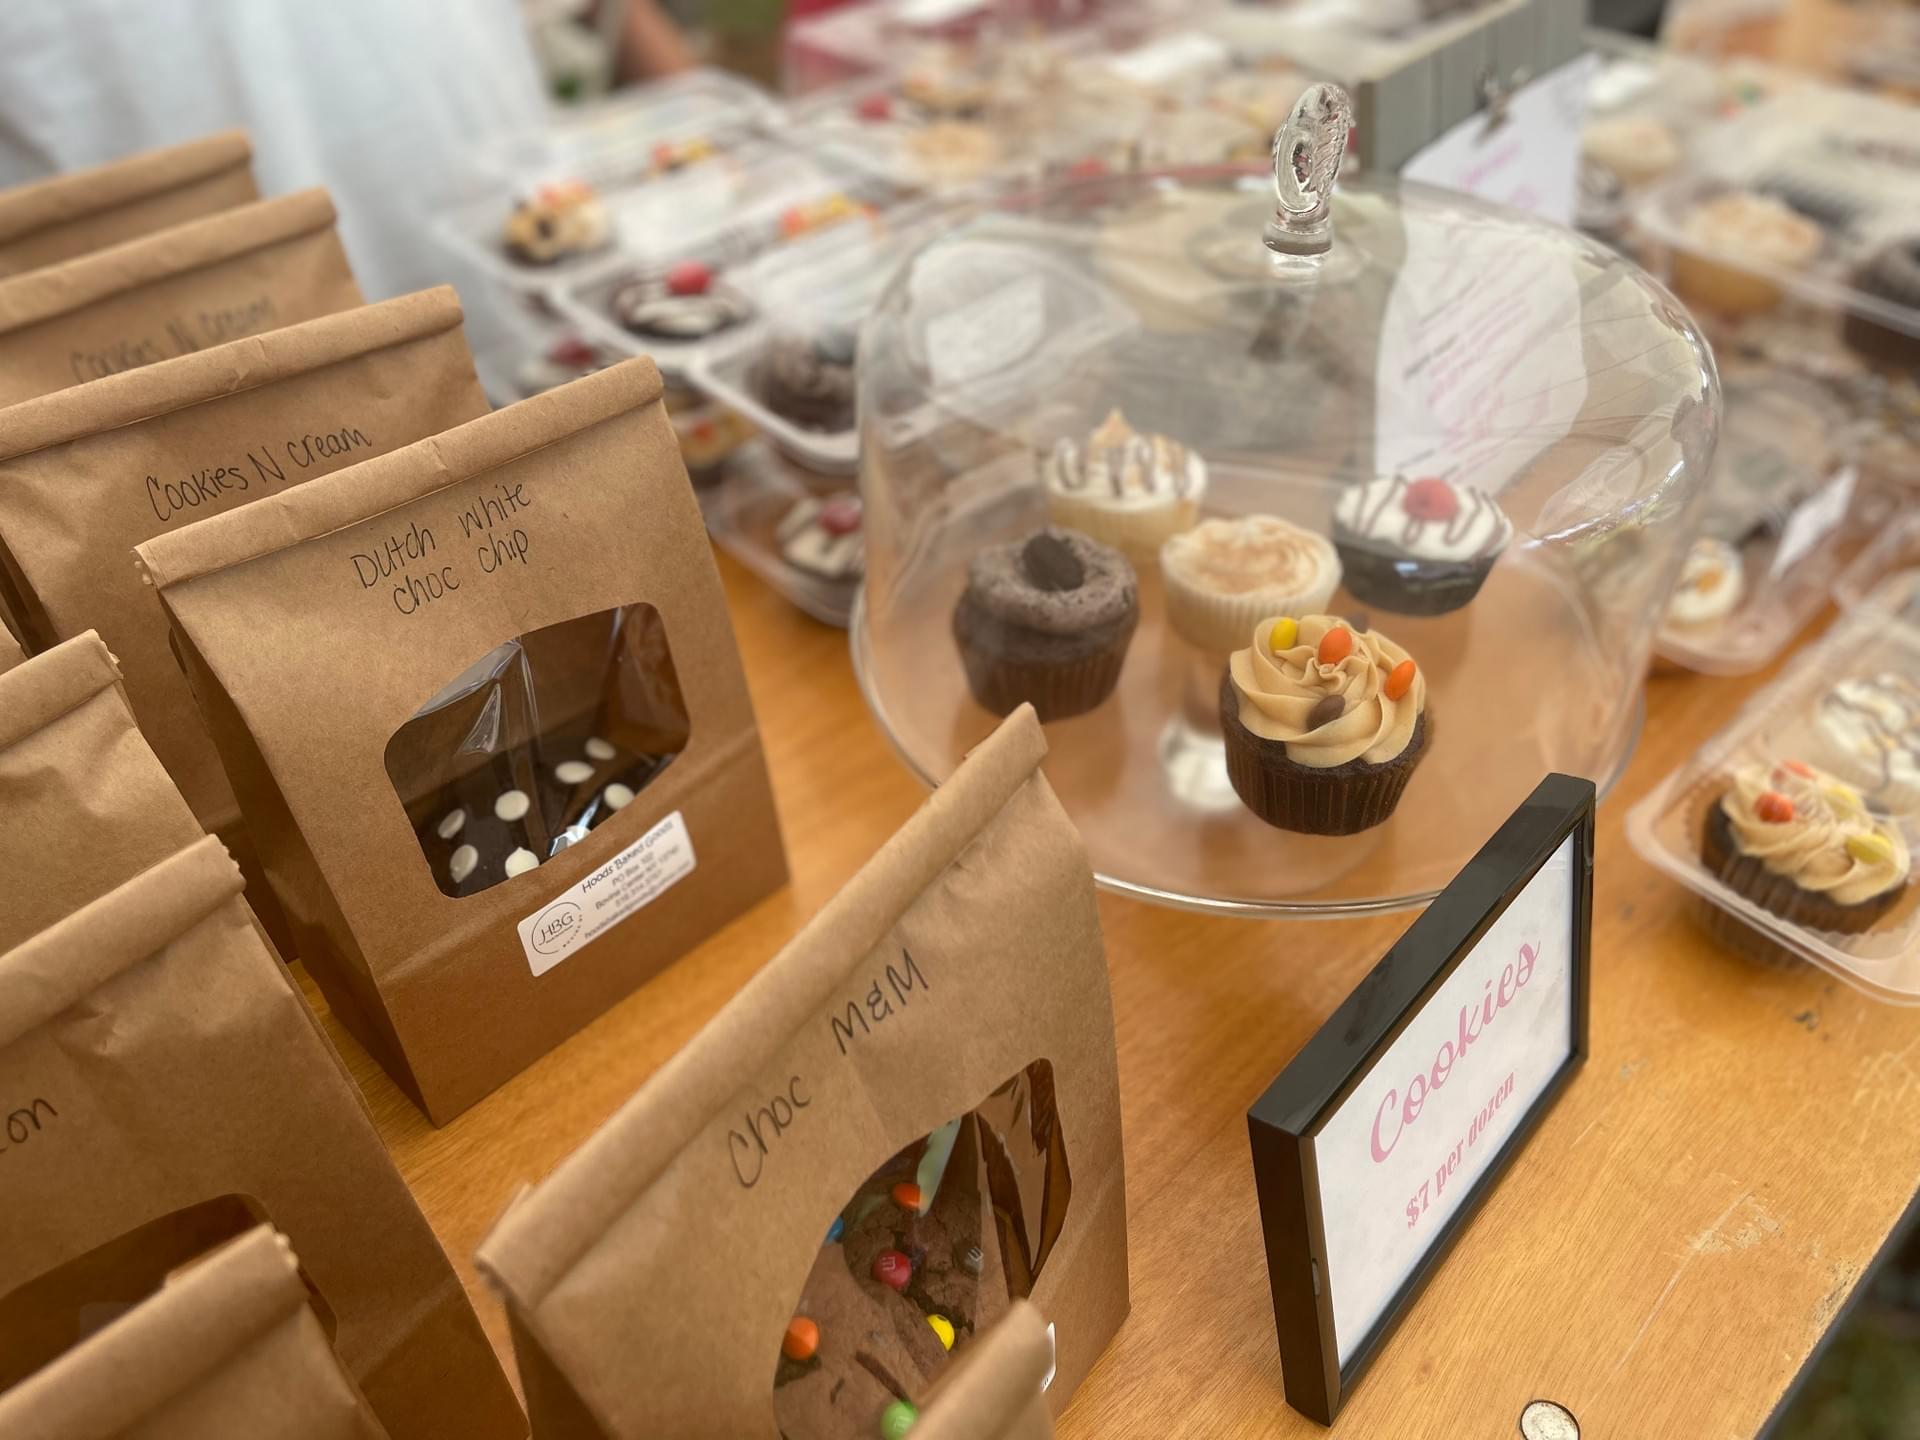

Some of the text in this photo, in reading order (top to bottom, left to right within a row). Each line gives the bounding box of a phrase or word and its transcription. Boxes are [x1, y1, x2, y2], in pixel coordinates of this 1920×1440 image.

[146, 465, 249, 522] Cookies
[248, 445, 286, 484] N
[350, 522, 437, 591] Dutch
[582, 866, 614, 893] Hoods
[538, 911, 574, 946] HBG
[1370, 940, 1541, 1164] Cookies
[0, 1097, 58, 1154] on
[727, 1075, 812, 1188] Choc
[1406, 1071, 1515, 1231] $7 per dozen
